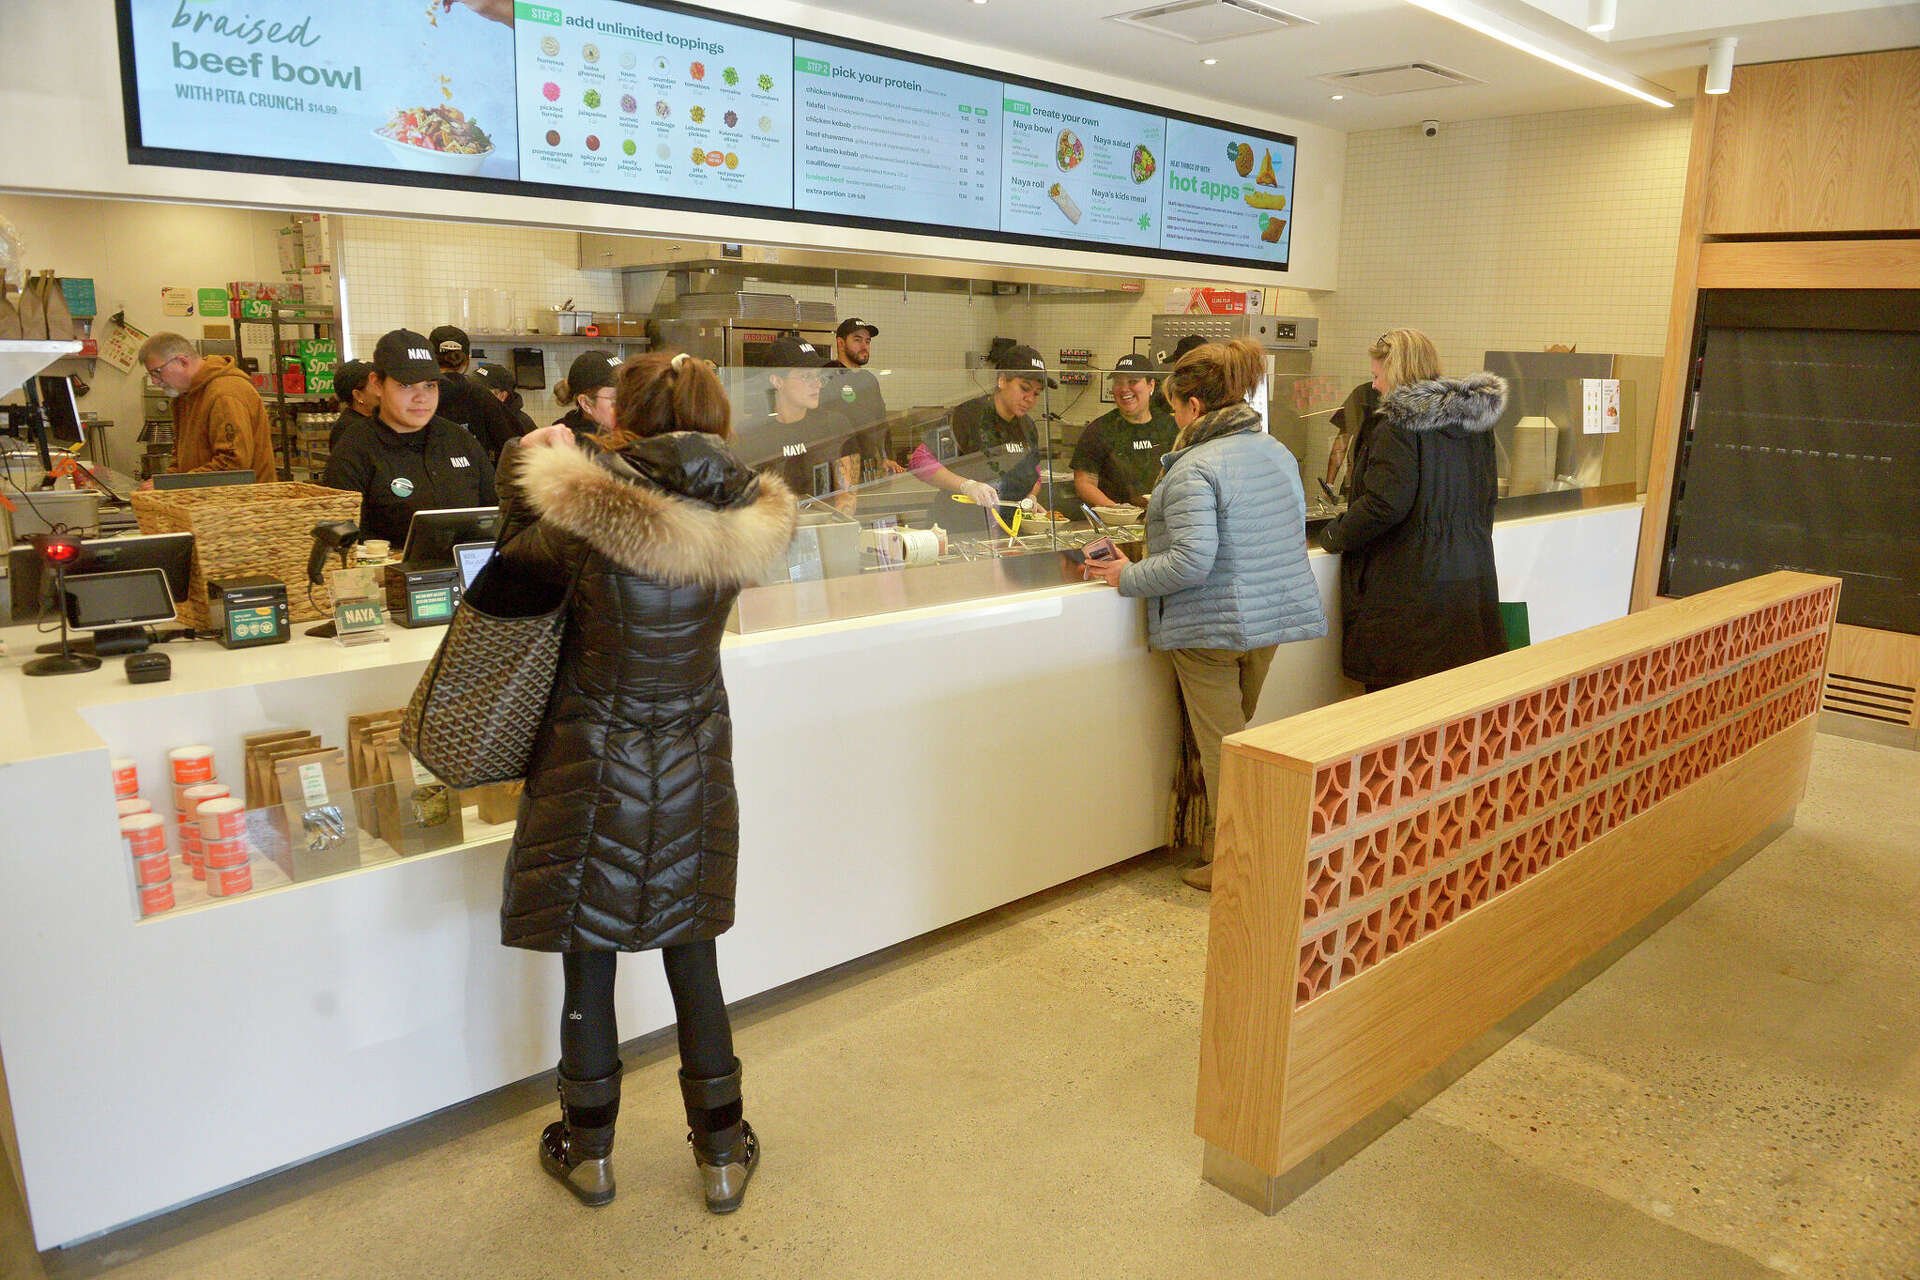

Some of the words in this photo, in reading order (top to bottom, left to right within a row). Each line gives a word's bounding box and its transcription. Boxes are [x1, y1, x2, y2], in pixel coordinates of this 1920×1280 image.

[532, 8, 552, 20] STEP
[553, 12, 560, 22] 3
[171, 0, 321, 47] braised
[566, 16, 594, 29] add
[597, 22, 663, 42] unlimited
[666, 32, 724, 55] toppings
[171, 42, 263, 78] beef
[272, 54, 362, 90] bowl
[832, 66, 856, 79] pick
[858, 72, 883, 84] your
[884, 78, 922, 92] protein
[176, 84, 212, 100] WITH
[216, 88, 246, 105] PITA
[250, 92, 304, 112] CRUNCH
[1033, 107, 1060, 119] create
[1062, 113, 1080, 122] your
[1081, 118, 1099, 127] own
[1013, 120, 1033, 131] Naya
[1034, 124, 1053, 134] bowl
[1094, 135, 1112, 145] Naya
[1112, 139, 1130, 149] salad
[1012, 176, 1031, 188] Naya
[1170, 169, 1198, 192] hot
[1200, 179, 1240, 202] apps
[1092, 188, 1114, 199] Naya's
[1115, 192, 1130, 200] kids
[408, 348, 432, 361] NAYA
[782, 442, 807, 457] NAYA
[1133, 440, 1153, 450] NAYA
[450, 456, 470, 468] NAYA
[344, 608, 376, 623] NAYA
